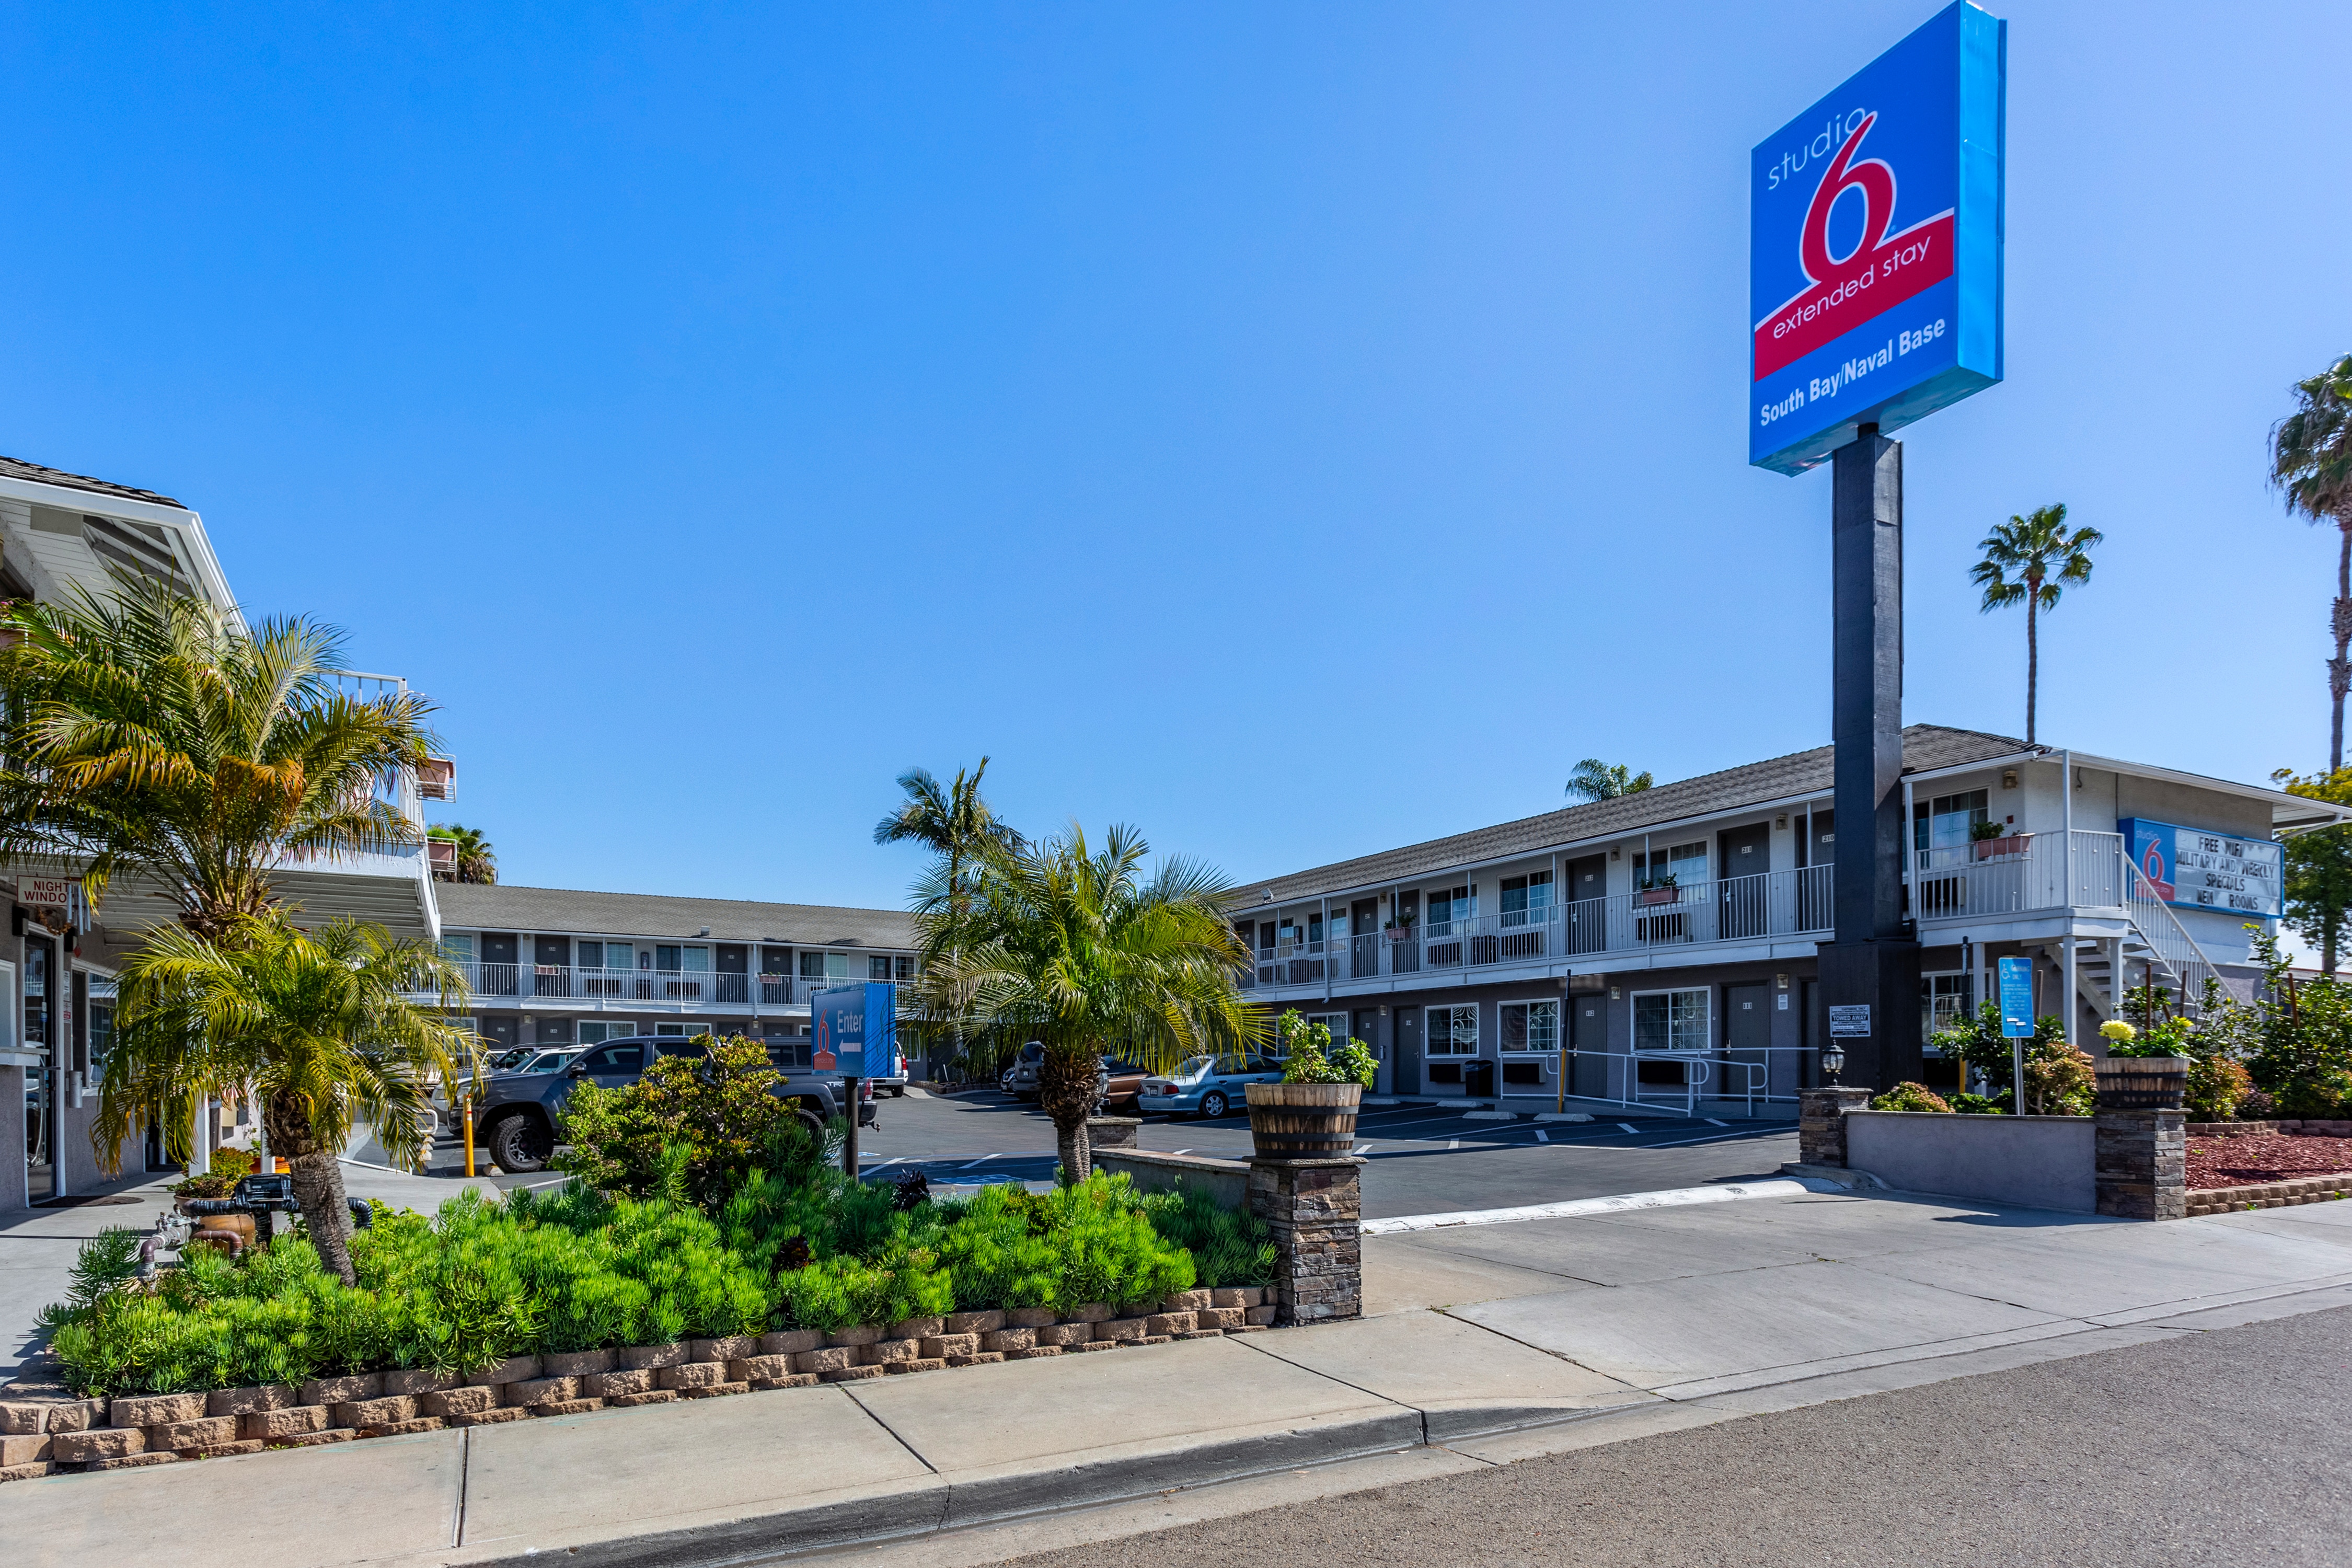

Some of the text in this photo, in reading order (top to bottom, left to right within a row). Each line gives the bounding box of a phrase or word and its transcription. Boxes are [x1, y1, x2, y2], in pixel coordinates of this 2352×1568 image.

[1768, 108, 1865, 190] studio
[1799, 110, 1897, 285] 6
[1773, 236, 1931, 339] extended stay
[1761, 319, 1945, 426] South Bay/Naval Base
[2142, 838, 2164, 882] 6
[2199, 837, 2242, 857] FREE WIFI
[2176, 850, 2274, 879] MILITARY AND WEEKLY
[34, 881, 70, 892] NIGHT
[2206, 873, 2245, 891] SPECIALS
[24, 891, 67, 903] WINDO
[2229, 894, 2258, 910] ROOMS
[818, 1008, 829, 1052] 6
[837, 1010, 863, 1033] Enter
